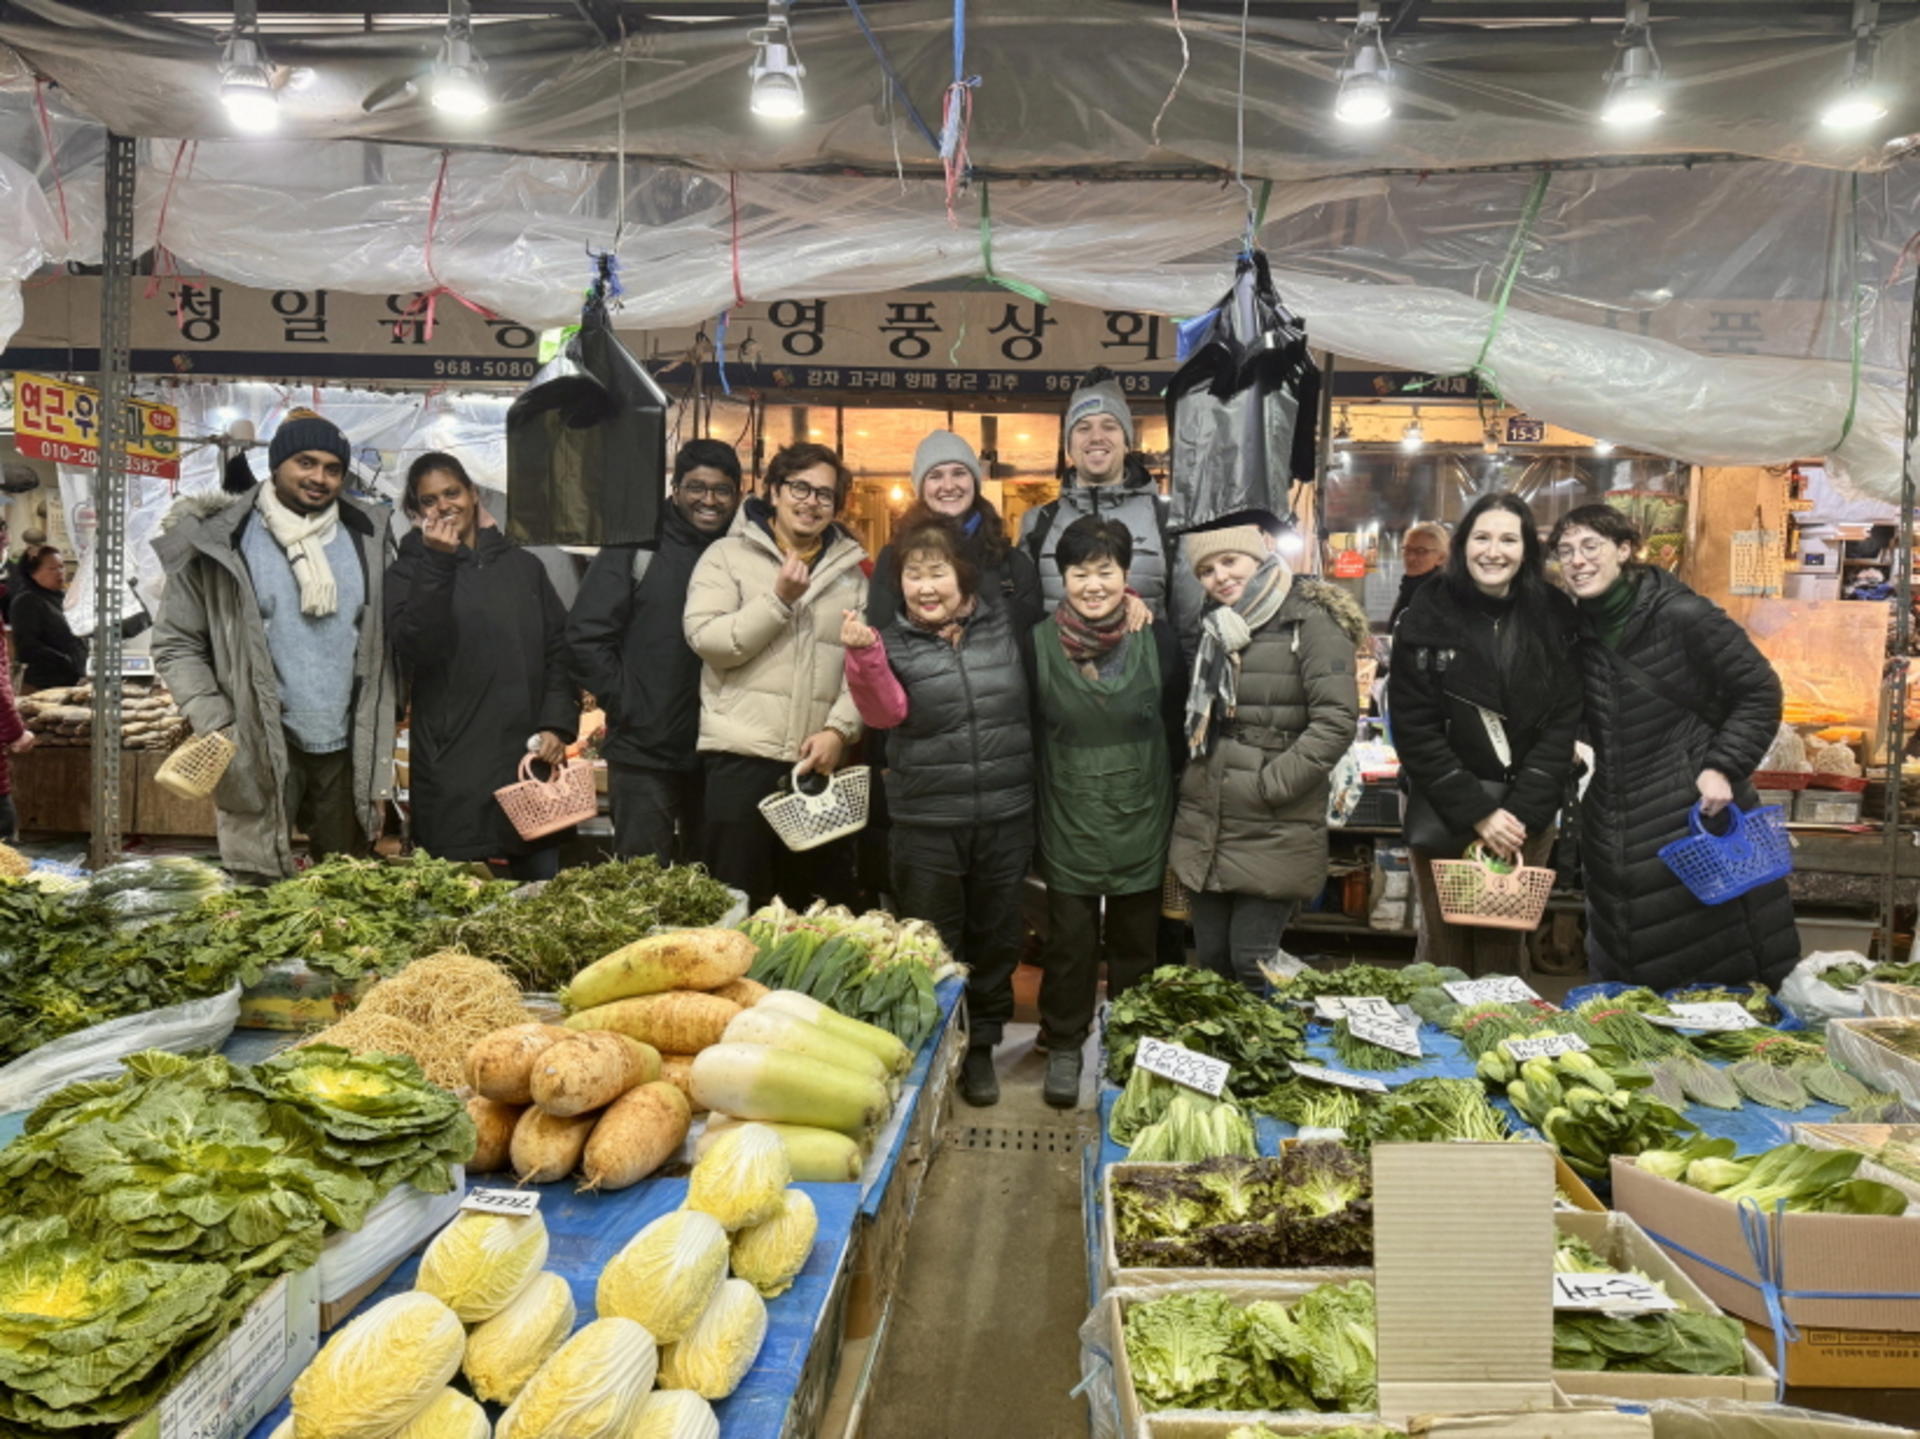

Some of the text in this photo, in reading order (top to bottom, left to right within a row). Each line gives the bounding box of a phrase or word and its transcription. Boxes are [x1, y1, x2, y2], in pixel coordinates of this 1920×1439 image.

[768, 299, 1160, 361] 영풍상회
[807, 369, 840, 387] 감자
[850, 371, 896, 388] 고구마
[904, 372, 937, 389] 양파
[945, 373, 978, 390] 당근
